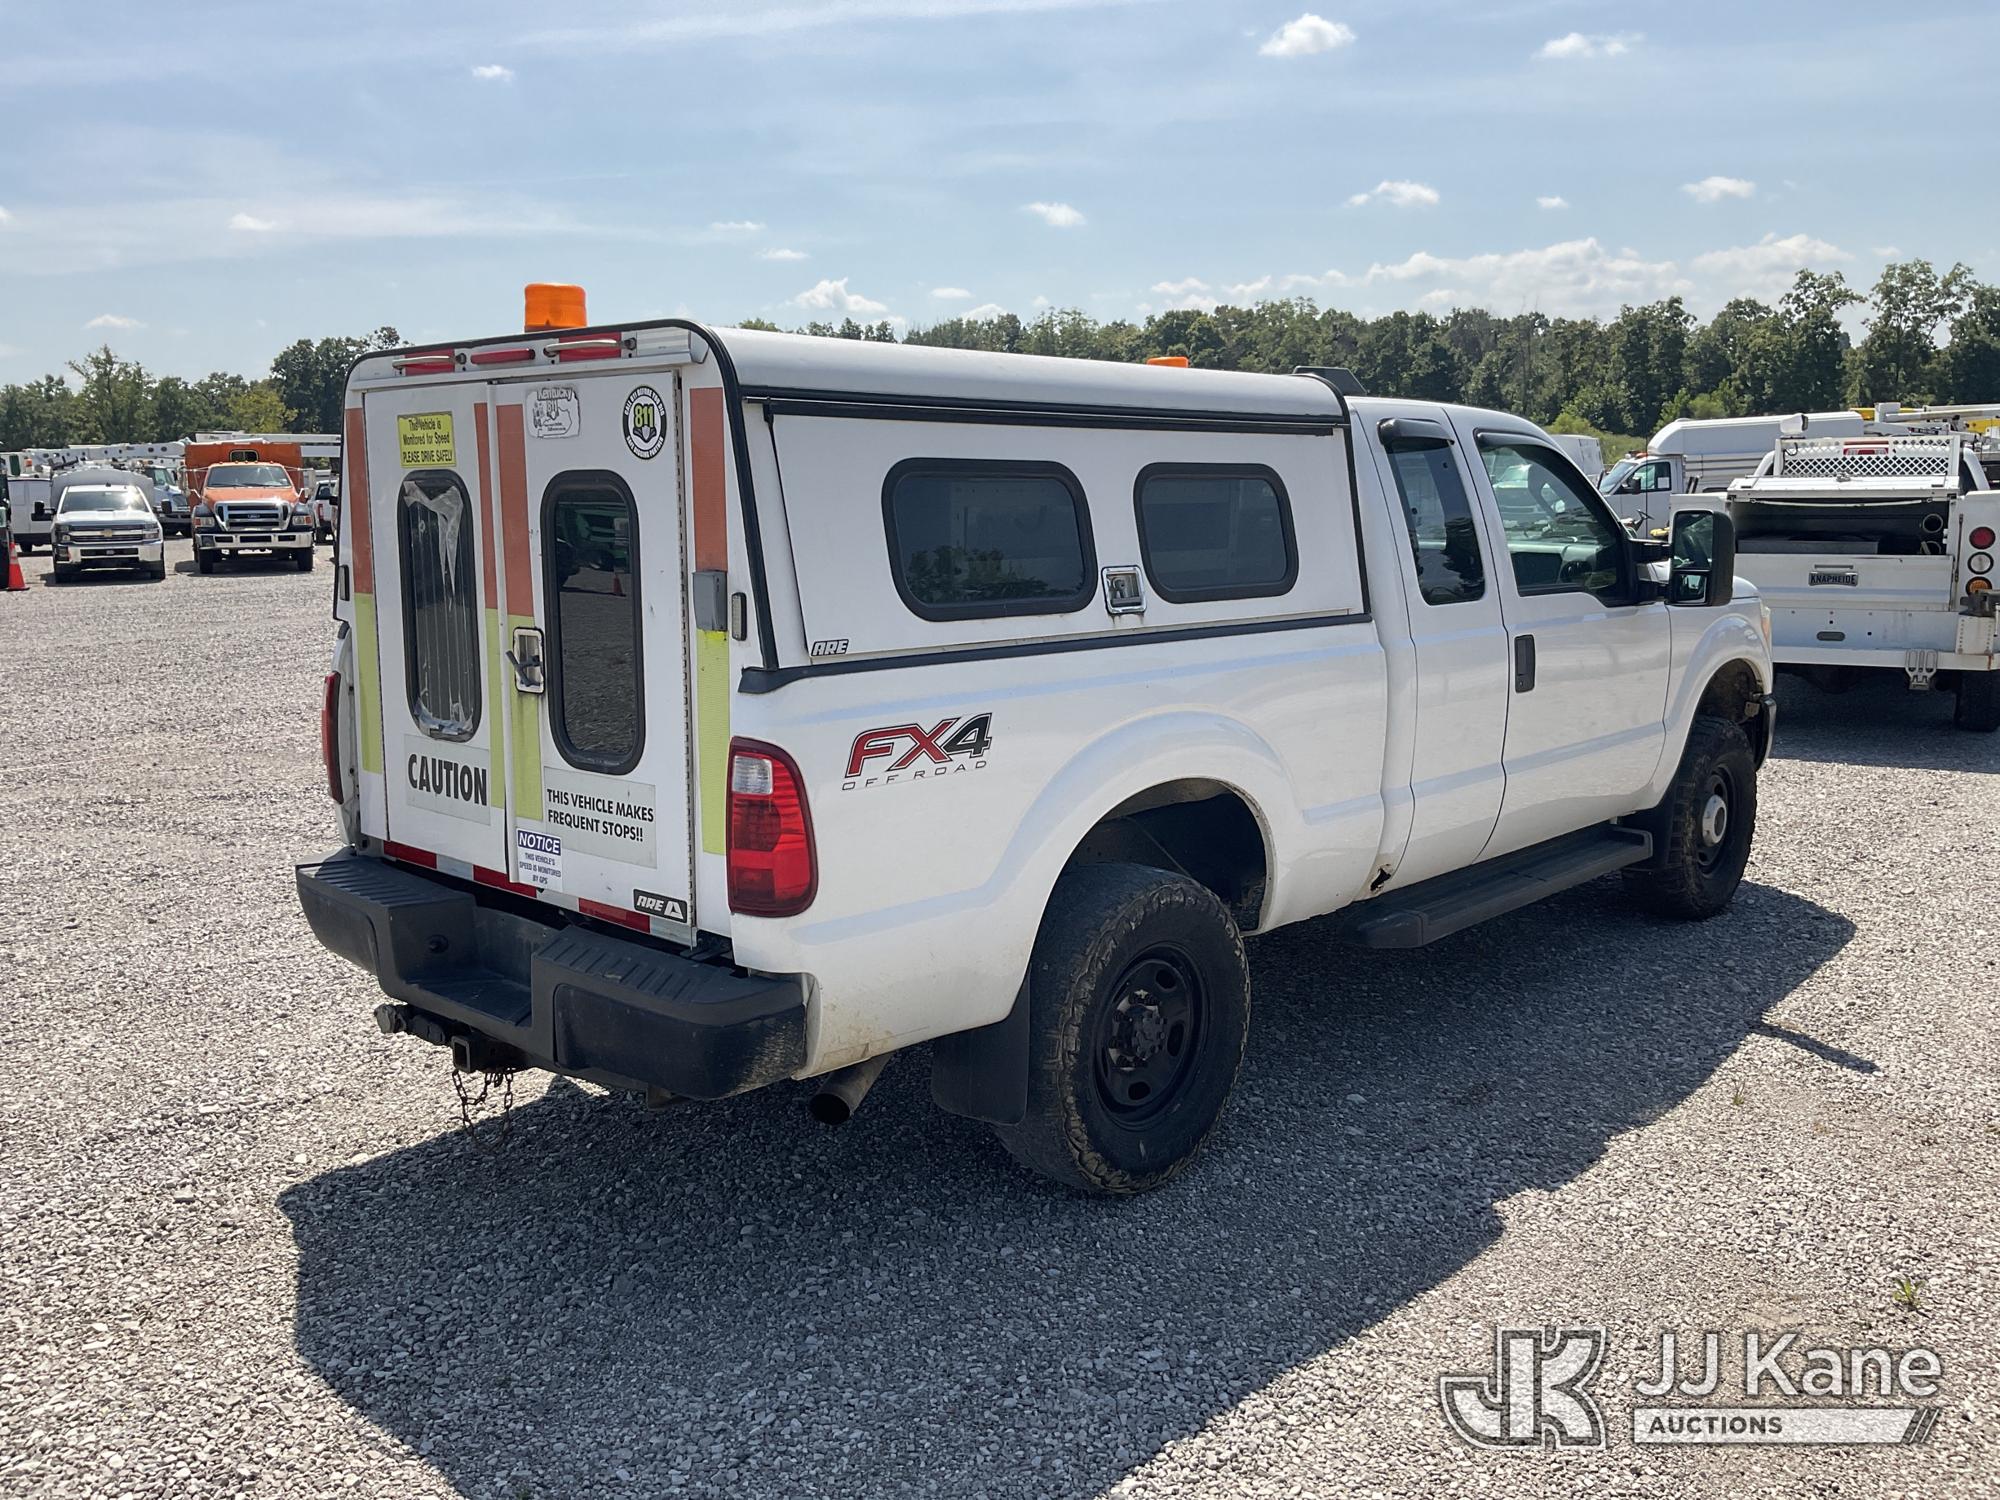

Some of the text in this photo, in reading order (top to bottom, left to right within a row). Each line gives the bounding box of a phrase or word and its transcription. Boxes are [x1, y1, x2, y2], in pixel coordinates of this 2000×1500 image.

[536, 387, 573, 401] Kentucky
[546, 400, 558, 412] 811
[418, 418, 436, 430] Vehicle
[436, 418, 442, 430] is
[634, 404, 654, 428] 811
[403, 434, 425, 446] Monitored
[434, 432, 450, 446] Speed
[402, 449, 452, 462] PLEASE DRIVE SAFELY
[1810, 574, 1856, 585] KNAPHEIDE
[811, 638, 849, 658] ARE
[844, 712, 992, 778] FX4
[408, 754, 488, 806] CAUTION
[842, 760, 988, 791] OFF ROAD
[547, 788, 654, 822] THIS VEHICLE MAKES
[548, 810, 643, 842] FREQUENT STOPS!!
[519, 832, 560, 854] NOTICE
[525, 852, 556, 866] THIS VEHICLE'S
[520, 862, 532, 870] SPEED
[538, 866, 562, 878] MONITORED
[539, 876, 548, 884] GPS
[636, 896, 664, 912] ARE
